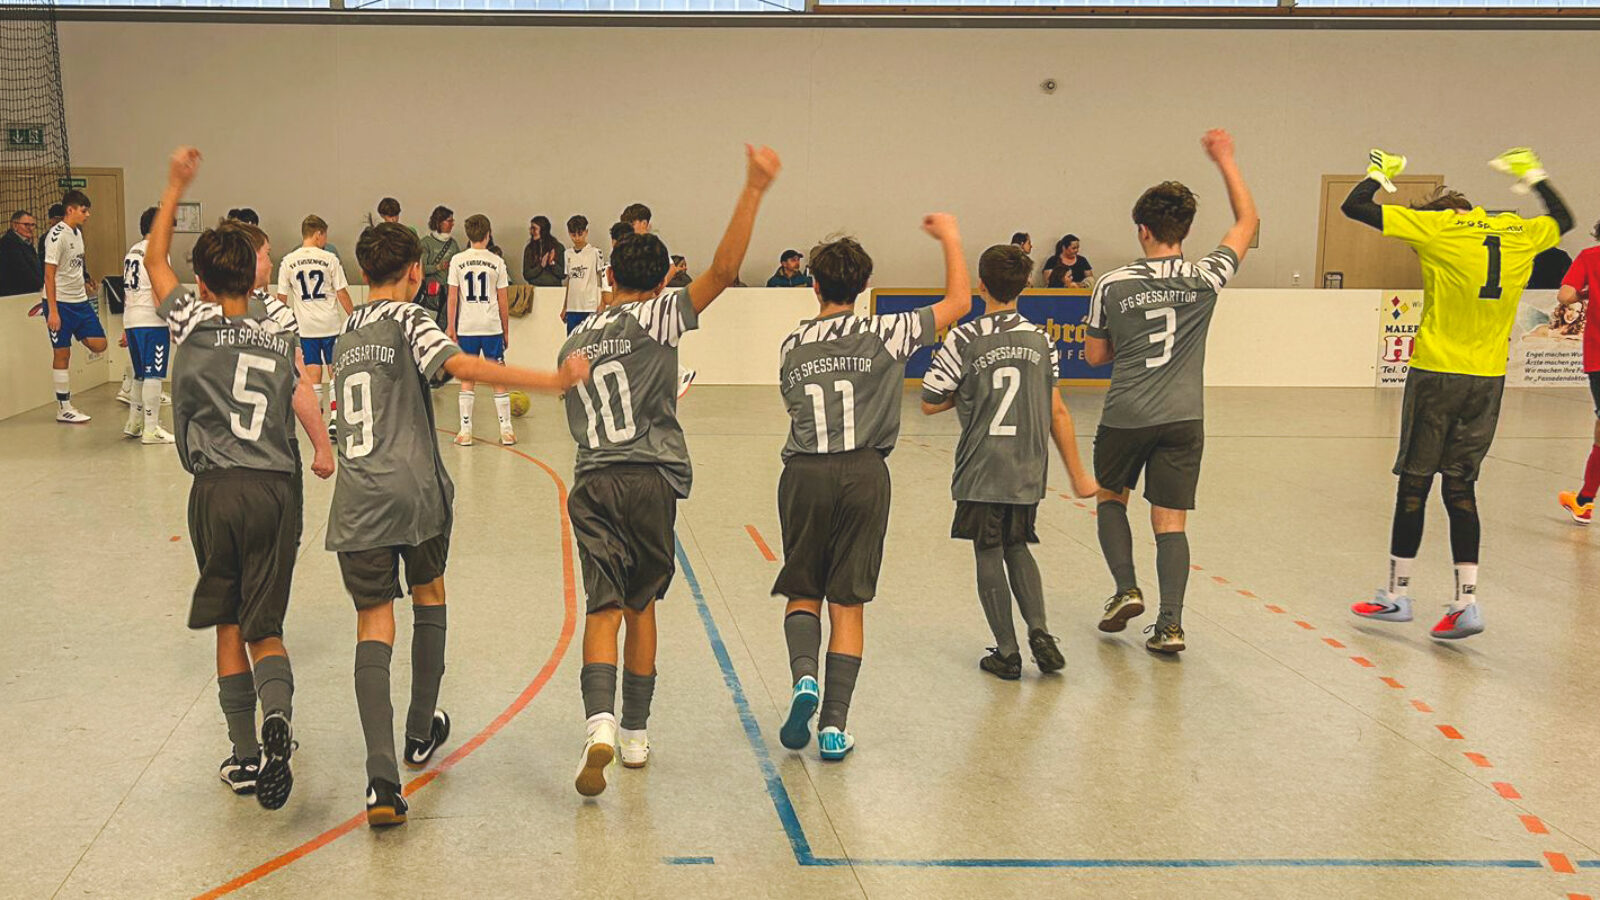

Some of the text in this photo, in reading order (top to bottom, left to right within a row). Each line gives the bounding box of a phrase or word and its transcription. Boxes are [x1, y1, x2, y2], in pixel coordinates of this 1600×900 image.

[124, 259, 141, 290] 23
[1478, 235, 1503, 300] 1
[296, 270, 327, 301] 12
[464, 271, 490, 303] 11
[1120, 290, 1197, 314] JFG SPESSARTTOR
[214, 328, 235, 346] JFG
[1145, 307, 1177, 369] 3
[1382, 336, 1415, 363] H
[972, 347, 1041, 375] JFG SPESSARTTOR
[1381, 366, 1398, 374] Tel.
[1526, 351, 1544, 359] Engel
[788, 356, 872, 388] JFG SPESSARTTOR
[229, 352, 276, 441] 5
[576, 360, 636, 449] 10
[989, 366, 1021, 436] 2
[343, 371, 374, 459] 9
[804, 380, 855, 454] 11
